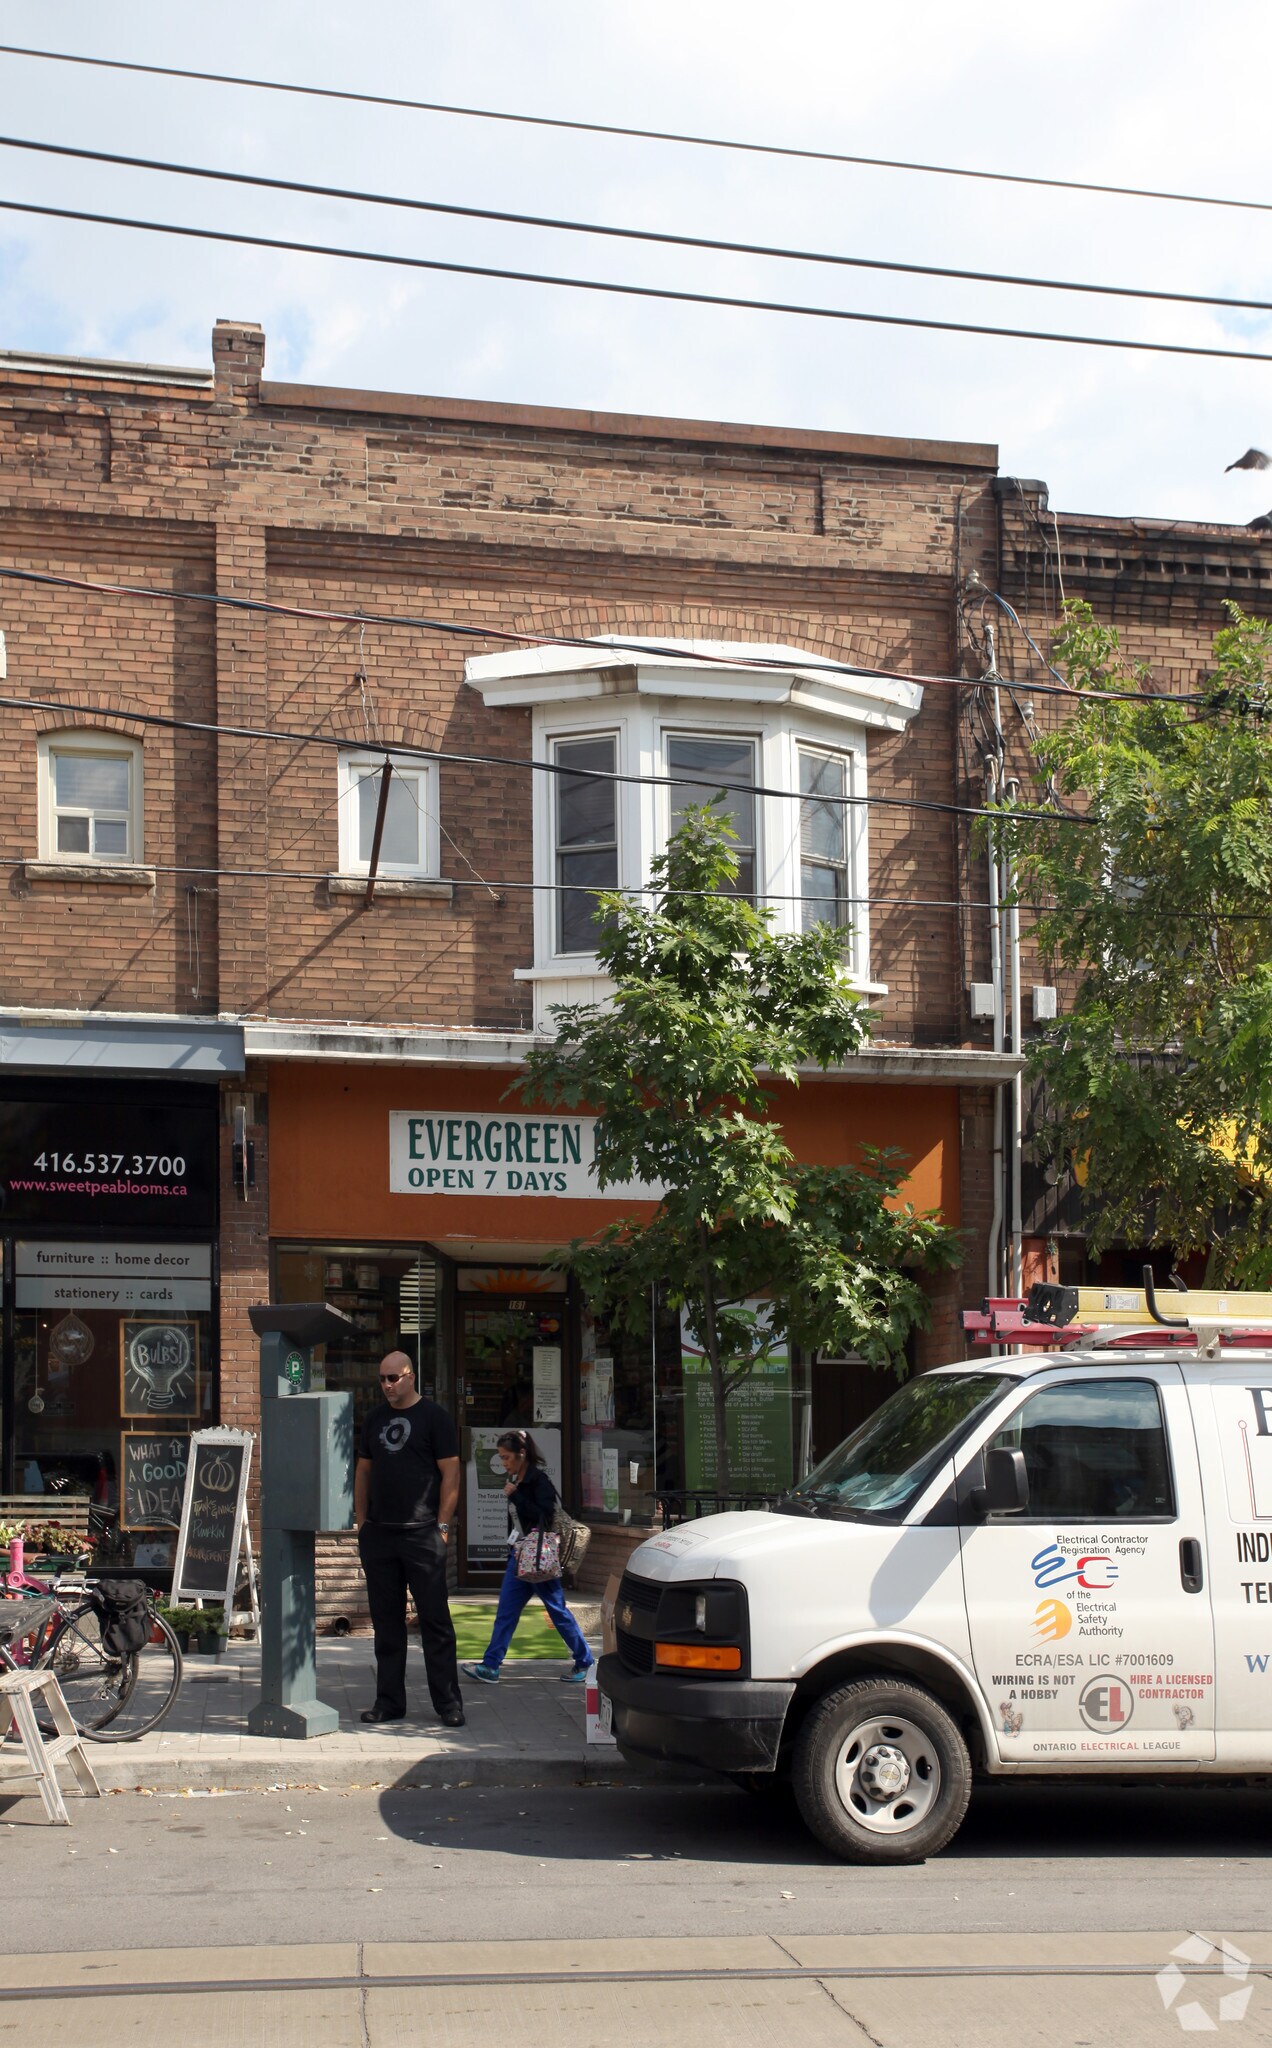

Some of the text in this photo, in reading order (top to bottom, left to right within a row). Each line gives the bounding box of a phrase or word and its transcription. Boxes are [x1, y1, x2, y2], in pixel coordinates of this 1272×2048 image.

[408, 1118, 582, 1165] EVERGREEN
[33, 1152, 186, 1177] 416.537.3700
[408, 1167, 568, 1192] OPEN 7 DAYS
[9, 1179, 188, 1197] www.sweetpeablooms.ca
[36, 1250, 95, 1265] furniture
[115, 1253, 150, 1265] home
[154, 1253, 190, 1266] decor
[54, 1287, 119, 1302] stationery
[140, 1288, 173, 1301] cards
[137, 1342, 183, 1366] BULBS!
[129, 1443, 162, 1461] WHAT
[142, 1460, 187, 1483] GOOD
[1056, 1535, 1149, 1545] Electrical Contractor
[1060, 1546, 1146, 1556] Registration Agency
[1236, 1532, 1272, 1562] IND
[1066, 1590, 1091, 1599] of the
[1076, 1602, 1116, 1612] Electrical
[1078, 1614, 1108, 1624] Safety
[1078, 1626, 1124, 1638] Authority
[1015, 1654, 1174, 1668] ECRA/ESA LIC #7001609
[992, 1675, 1076, 1686] WIRING IS NOT
[1130, 1674, 1213, 1685] HIRE A LICENSED
[1009, 1690, 1059, 1700] A HOBBY
[1139, 1689, 1204, 1699] CONTRACTOR
[1033, 1741, 1181, 1751] ONTARIO ELECTRICAL LEAGUE
